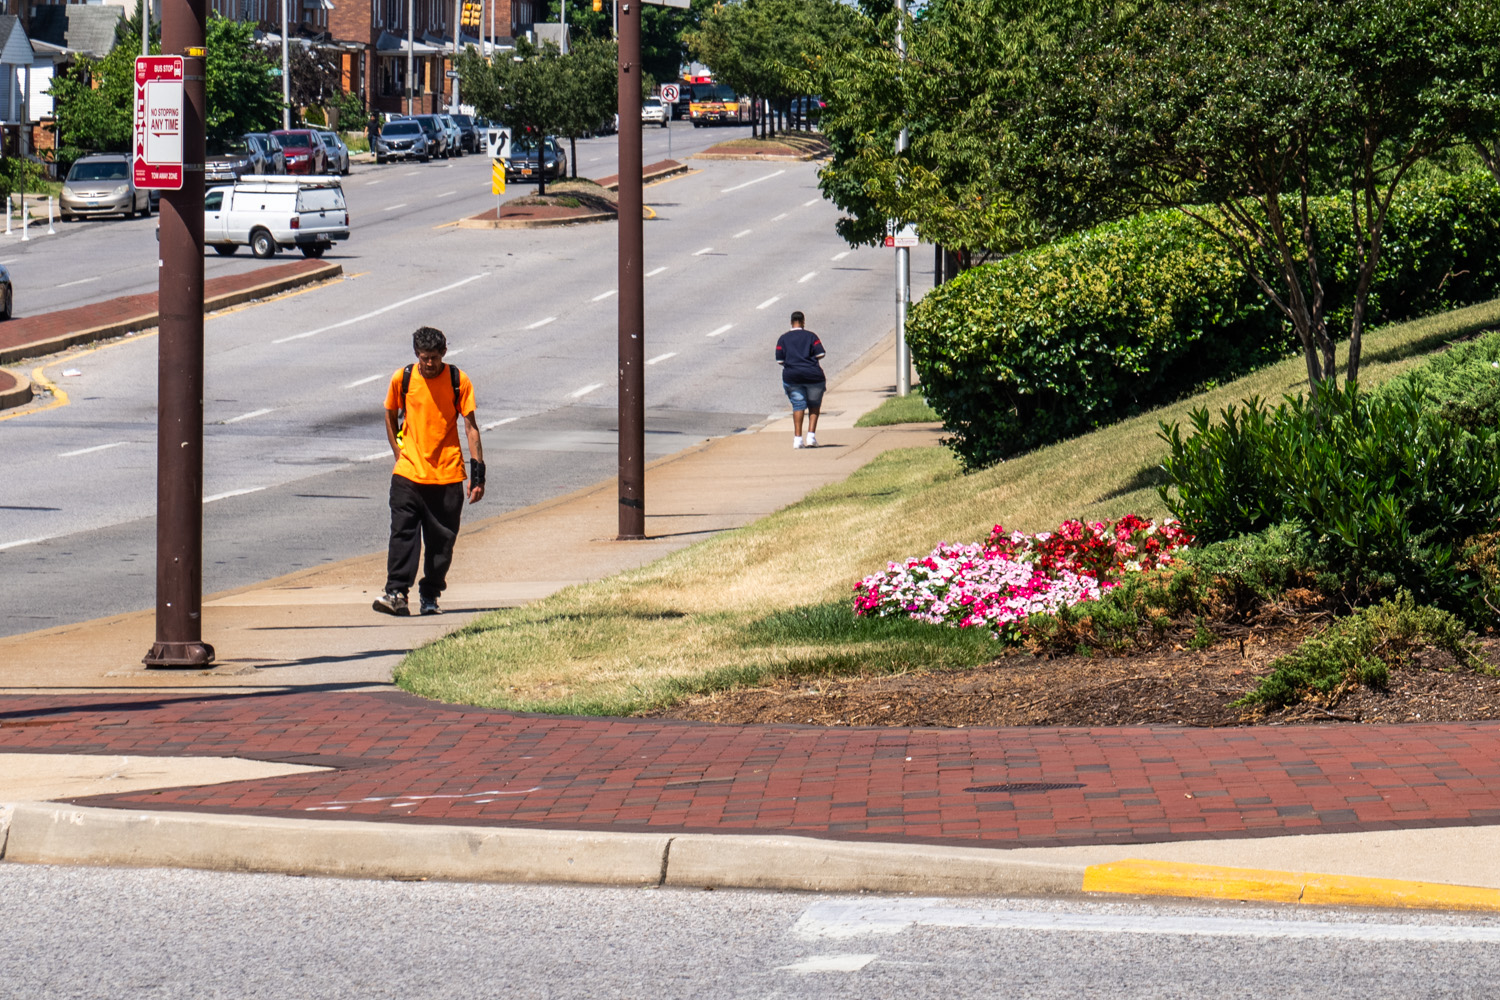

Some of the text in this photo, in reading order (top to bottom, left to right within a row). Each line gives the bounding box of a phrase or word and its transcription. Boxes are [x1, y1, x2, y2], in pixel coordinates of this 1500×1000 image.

[154, 64, 163, 73] BUS
[163, 64, 174, 73] STOP
[151, 108, 158, 117] NO
[158, 108, 179, 117] STOPPING
[151, 118, 179, 131] ANY TIME
[168, 172, 178, 180] ZONE
